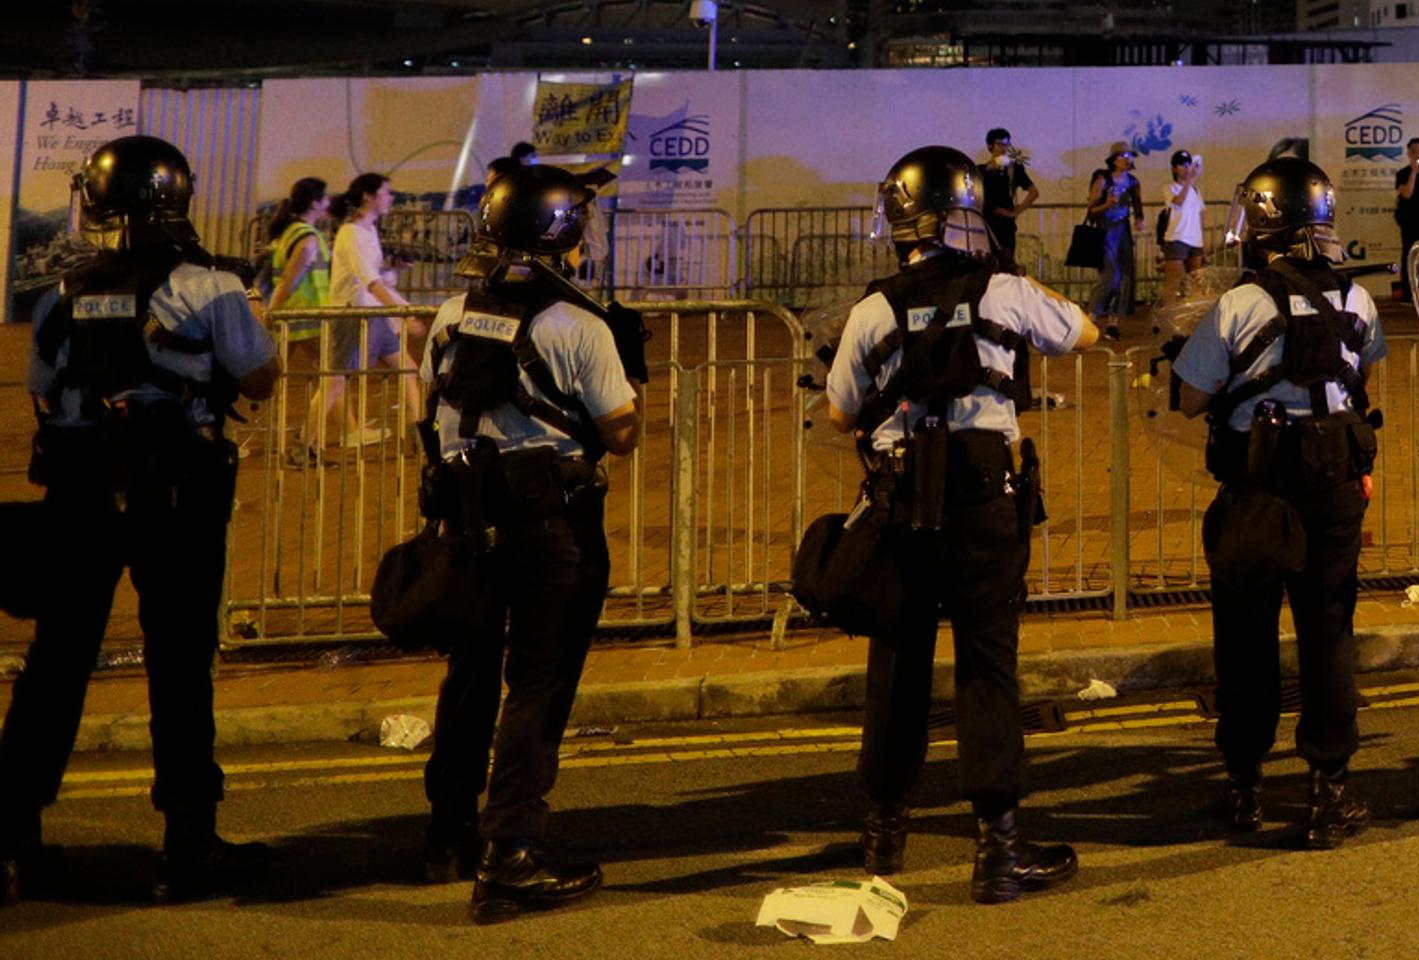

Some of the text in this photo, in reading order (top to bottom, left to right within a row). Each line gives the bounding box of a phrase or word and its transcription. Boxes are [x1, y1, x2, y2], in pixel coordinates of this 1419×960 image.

[535, 129, 569, 146] Way
[575, 131, 592, 144] to
[1345, 125, 1403, 145] CEDD
[650, 137, 710, 156] CEDD
[465, 316, 513, 336] POLICE
